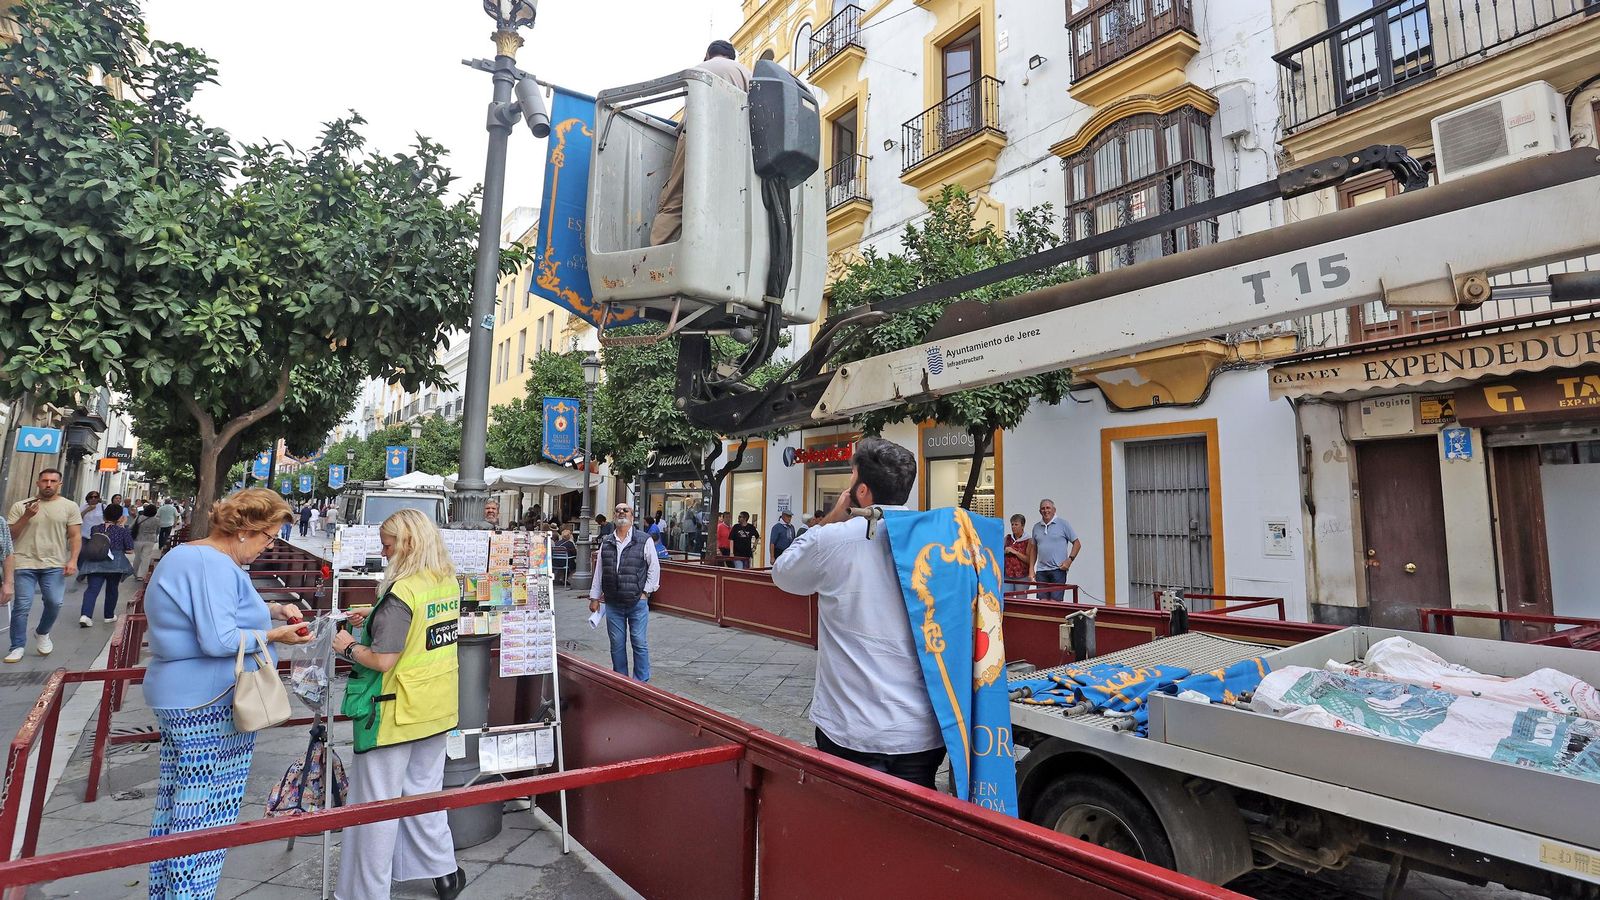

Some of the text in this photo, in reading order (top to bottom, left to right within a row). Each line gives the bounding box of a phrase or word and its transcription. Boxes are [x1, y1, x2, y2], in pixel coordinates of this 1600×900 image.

[1242, 253, 1350, 304] T 15
[946, 327, 1041, 358] Ayuntamiento de Jerez
[947, 354, 984, 368] Infraestructura
[1273, 368, 1341, 384] GARVEY
[1374, 398, 1410, 408] Logista
[1560, 399, 1585, 407] EXP.
[928, 432, 975, 447] audiolog
[436, 600, 458, 613] ONCE
[436, 625, 450, 634] grupo
[436, 630, 458, 644] ONCE
